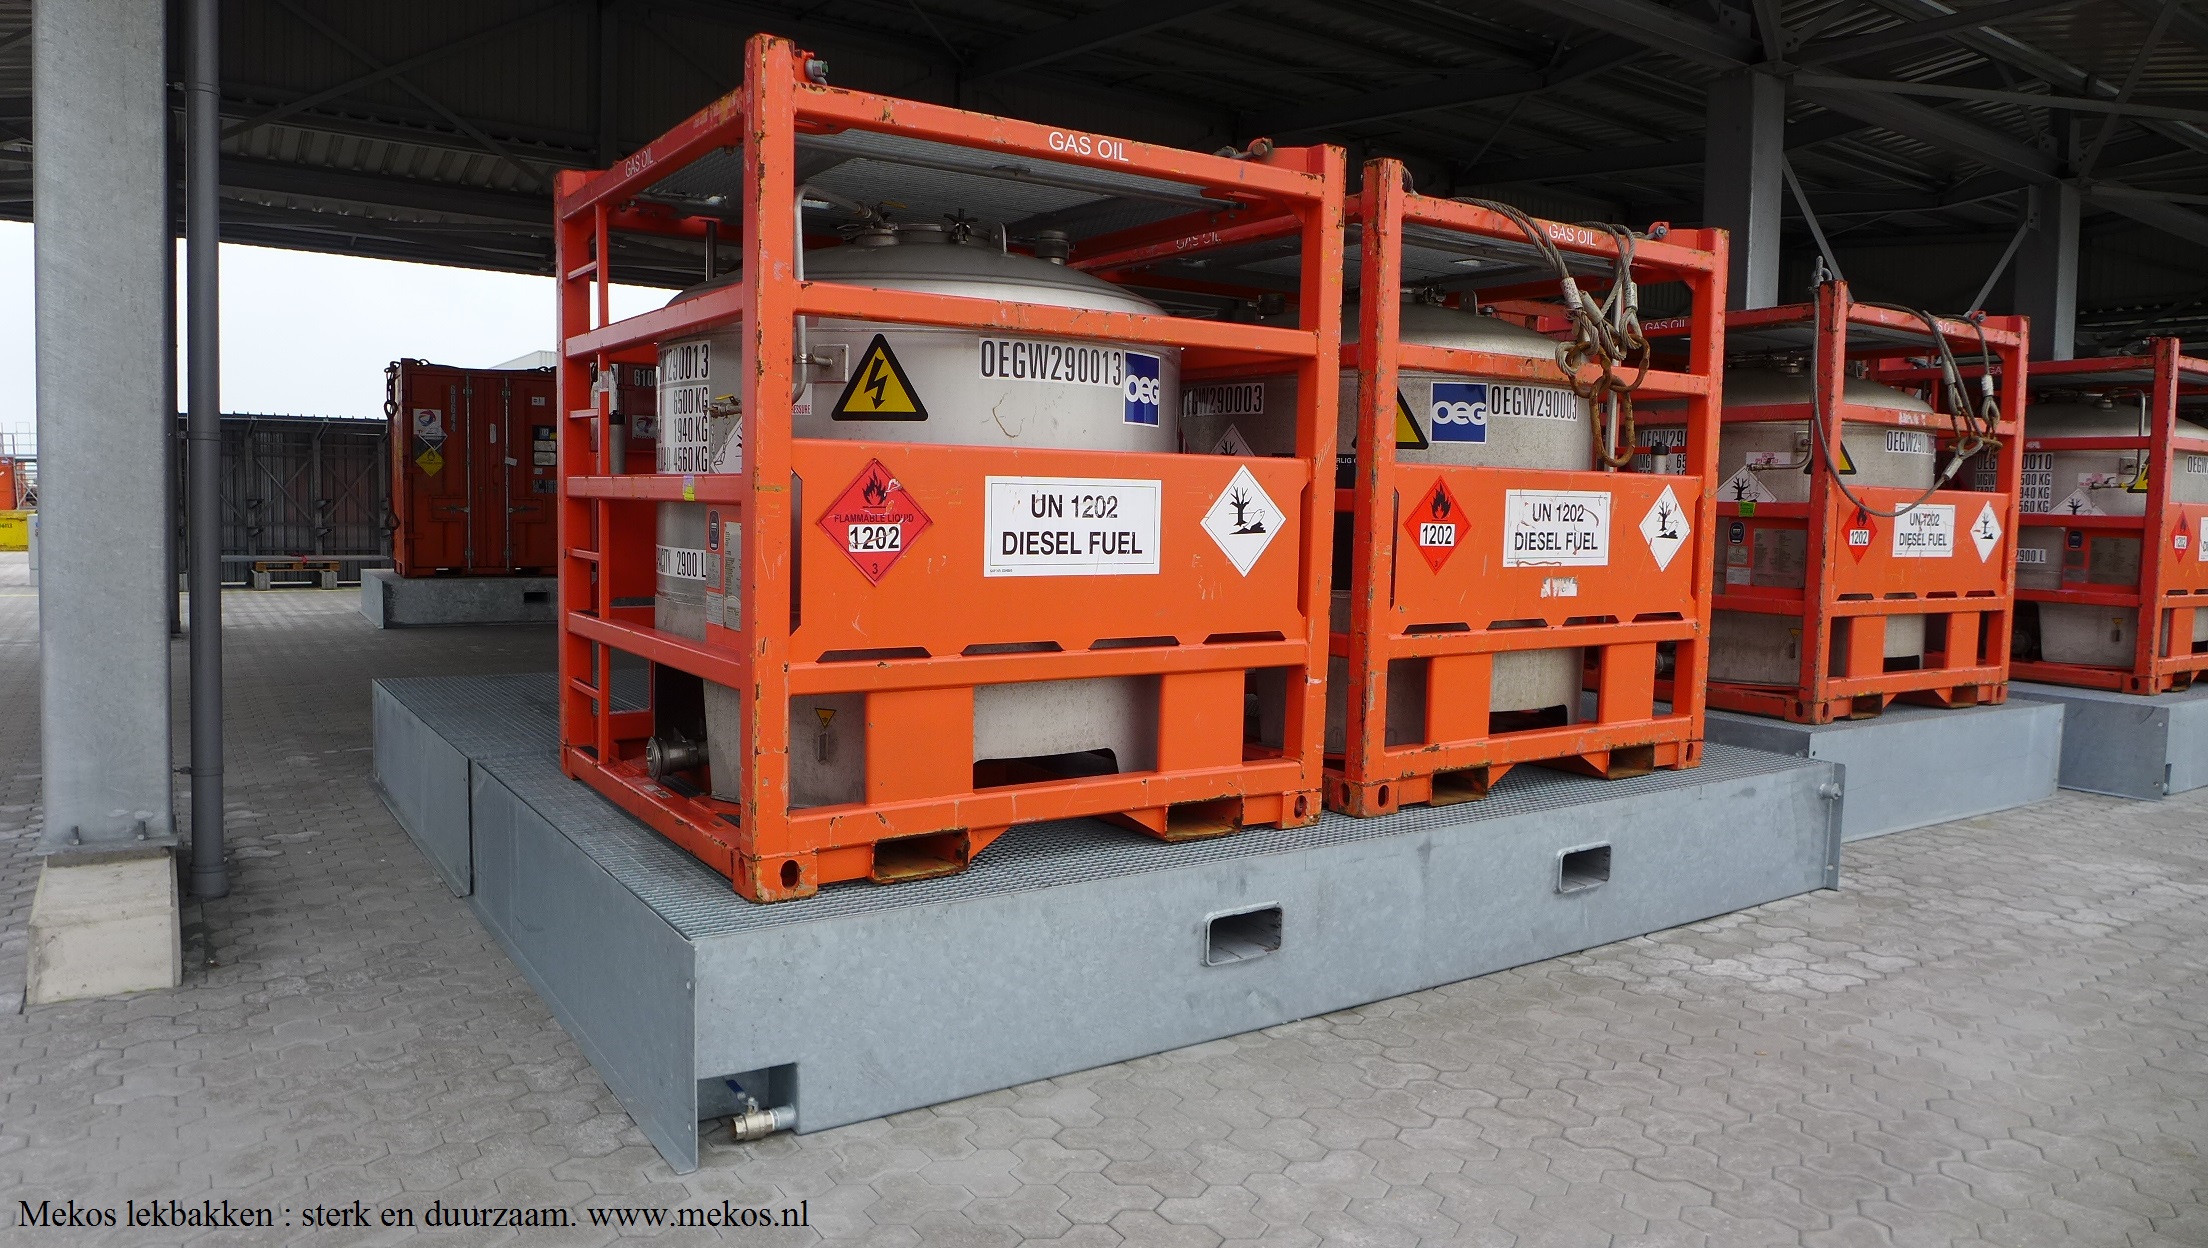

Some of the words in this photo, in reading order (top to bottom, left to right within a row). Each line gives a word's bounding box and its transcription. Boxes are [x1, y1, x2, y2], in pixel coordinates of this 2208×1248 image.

[1049, 131, 1091, 155] GAS
[1097, 140, 1129, 161] OIL
[626, 155, 640, 177] GAS
[642, 147, 653, 168] OIL
[1549, 224, 1574, 241] GAS
[1578, 230, 1596, 246] OIL
[981, 340, 1122, 386] OEGW290013
[673, 388, 693, 415] 6500
[695, 387, 708, 414] KG
[1491, 386, 1577, 420] OEGW290003
[673, 417, 693, 443] 1940
[695, 416, 708, 442] KG
[673, 446, 693, 472] 4560
[695, 446, 708, 472] KG
[1676, 454, 1686, 469] 65
[2022, 454, 2052, 470] 0010
[2020, 474, 2037, 486] 500
[2039, 473, 2051, 486] KG
[2020, 487, 2036, 499] 940
[2038, 486, 2050, 499] KG
[1031, 494, 1063, 518] UN
[1071, 495, 1118, 518] 1202
[1532, 503, 1552, 522] UN
[1556, 503, 1584, 522] 1202
[2019, 500, 2035, 513] 560
[2037, 500, 2049, 513] KG
[834, 513, 885, 523] FLAMMABLE
[887, 513, 914, 523] LIQUID
[1910, 513, 1921, 526] UN
[1923, 513, 1940, 527] 1202
[850, 526, 900, 550] 1202
[1002, 531, 1082, 556] DIESEL
[1089, 531, 1142, 555] FUEL
[1422, 525, 1452, 544] 1202
[1515, 532, 1561, 550] DIESEL
[1566, 532, 1598, 550] FUEL
[1851, 531, 1868, 544] 1202
[1899, 532, 1926, 546] DIESEL
[1928, 533, 1947, 546] FUEL
[677, 551, 697, 577] 2900
[701, 552, 706, 578] L
[872, 563, 879, 574] 3
